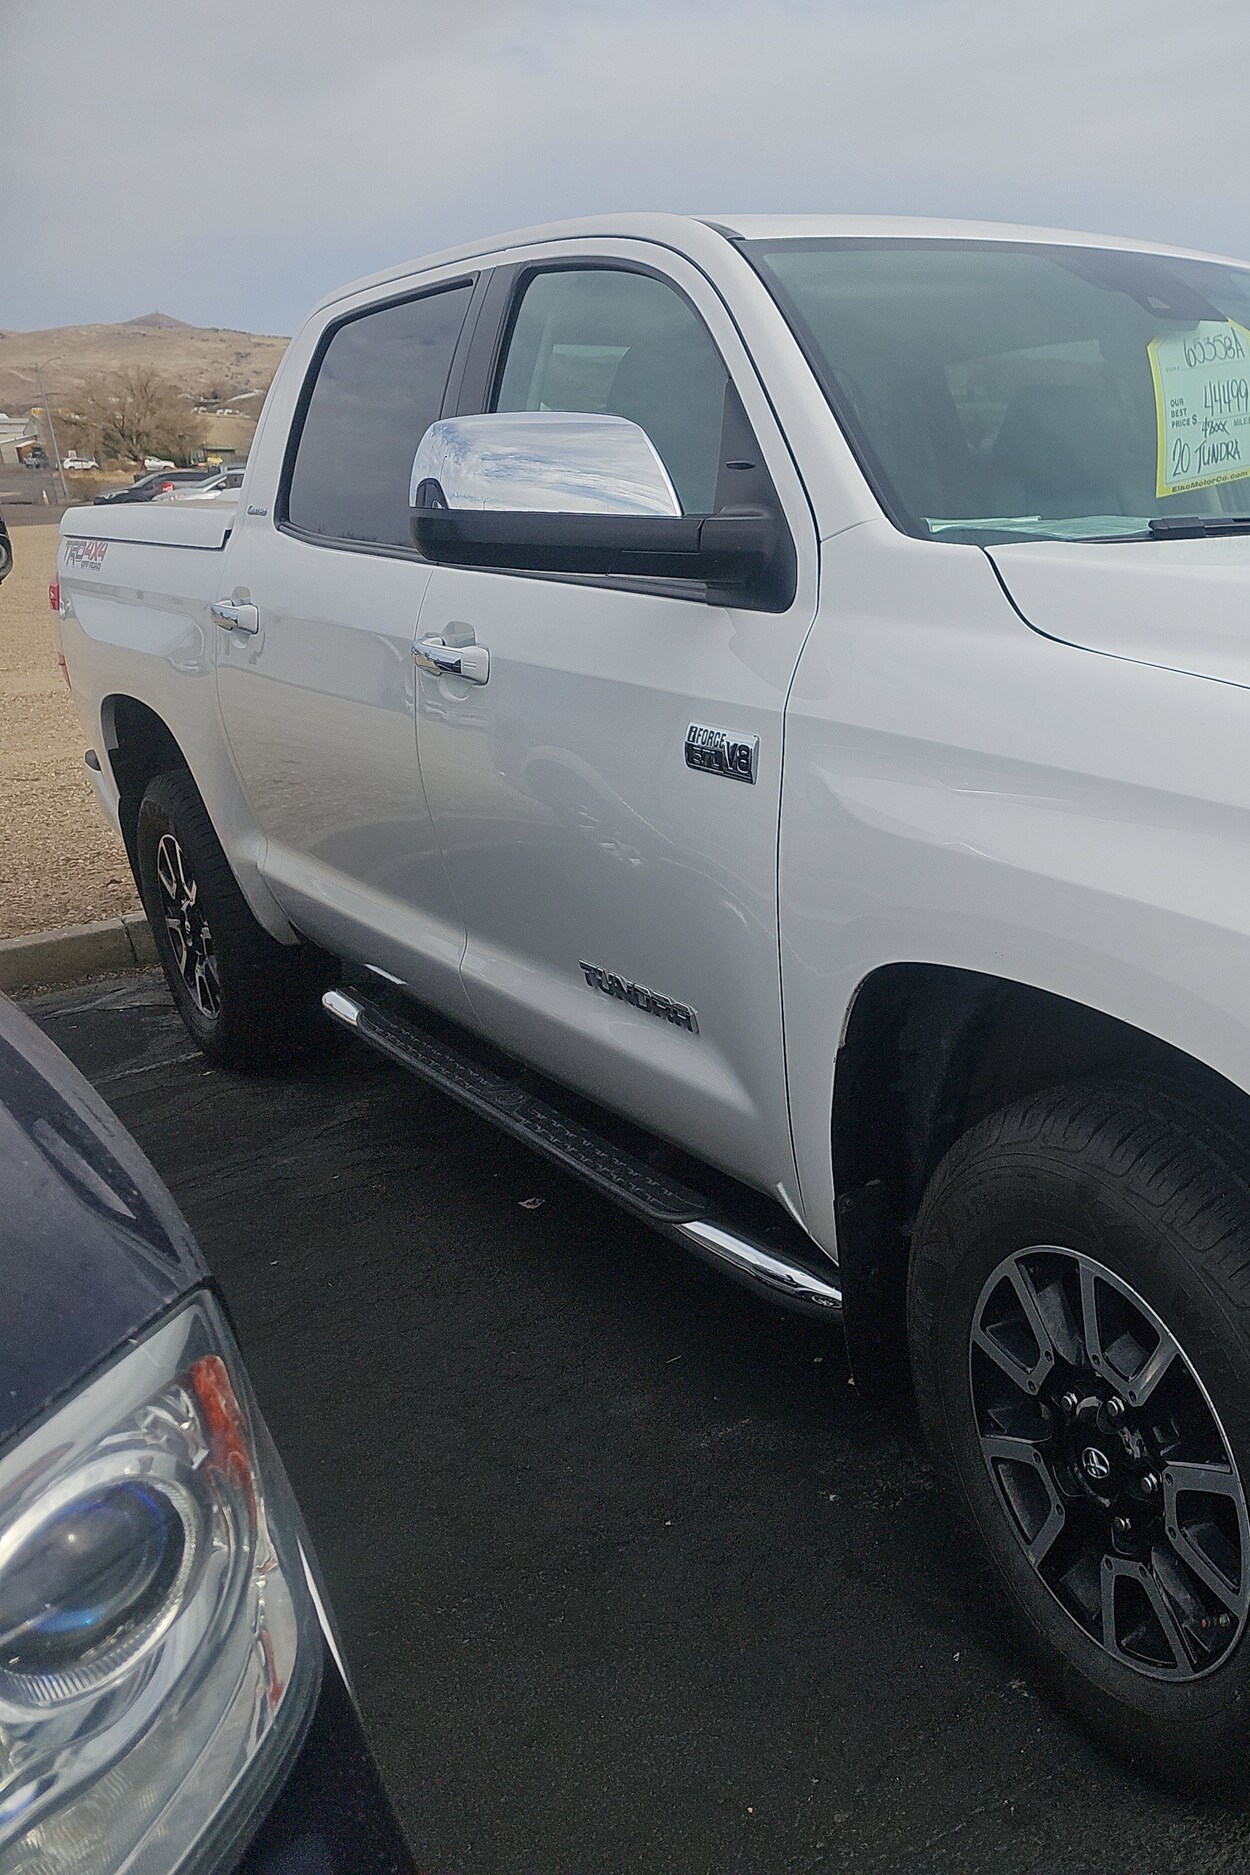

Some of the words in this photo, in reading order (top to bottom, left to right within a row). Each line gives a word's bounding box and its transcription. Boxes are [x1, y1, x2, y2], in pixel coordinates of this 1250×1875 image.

[1169, 398, 1184, 408] OUR
[1203, 378, 1249, 417] 44499
[1170, 408, 1188, 419] BEST
[1171, 418, 1190, 429] PRICE
[1172, 437, 1191, 477] 20
[1194, 438, 1241, 474] TUNDRA
[1171, 470, 1248, 493] ElkoMotorCo.com
[723, 740, 750, 774] V8
[579, 959, 700, 1035] TUNDRA
